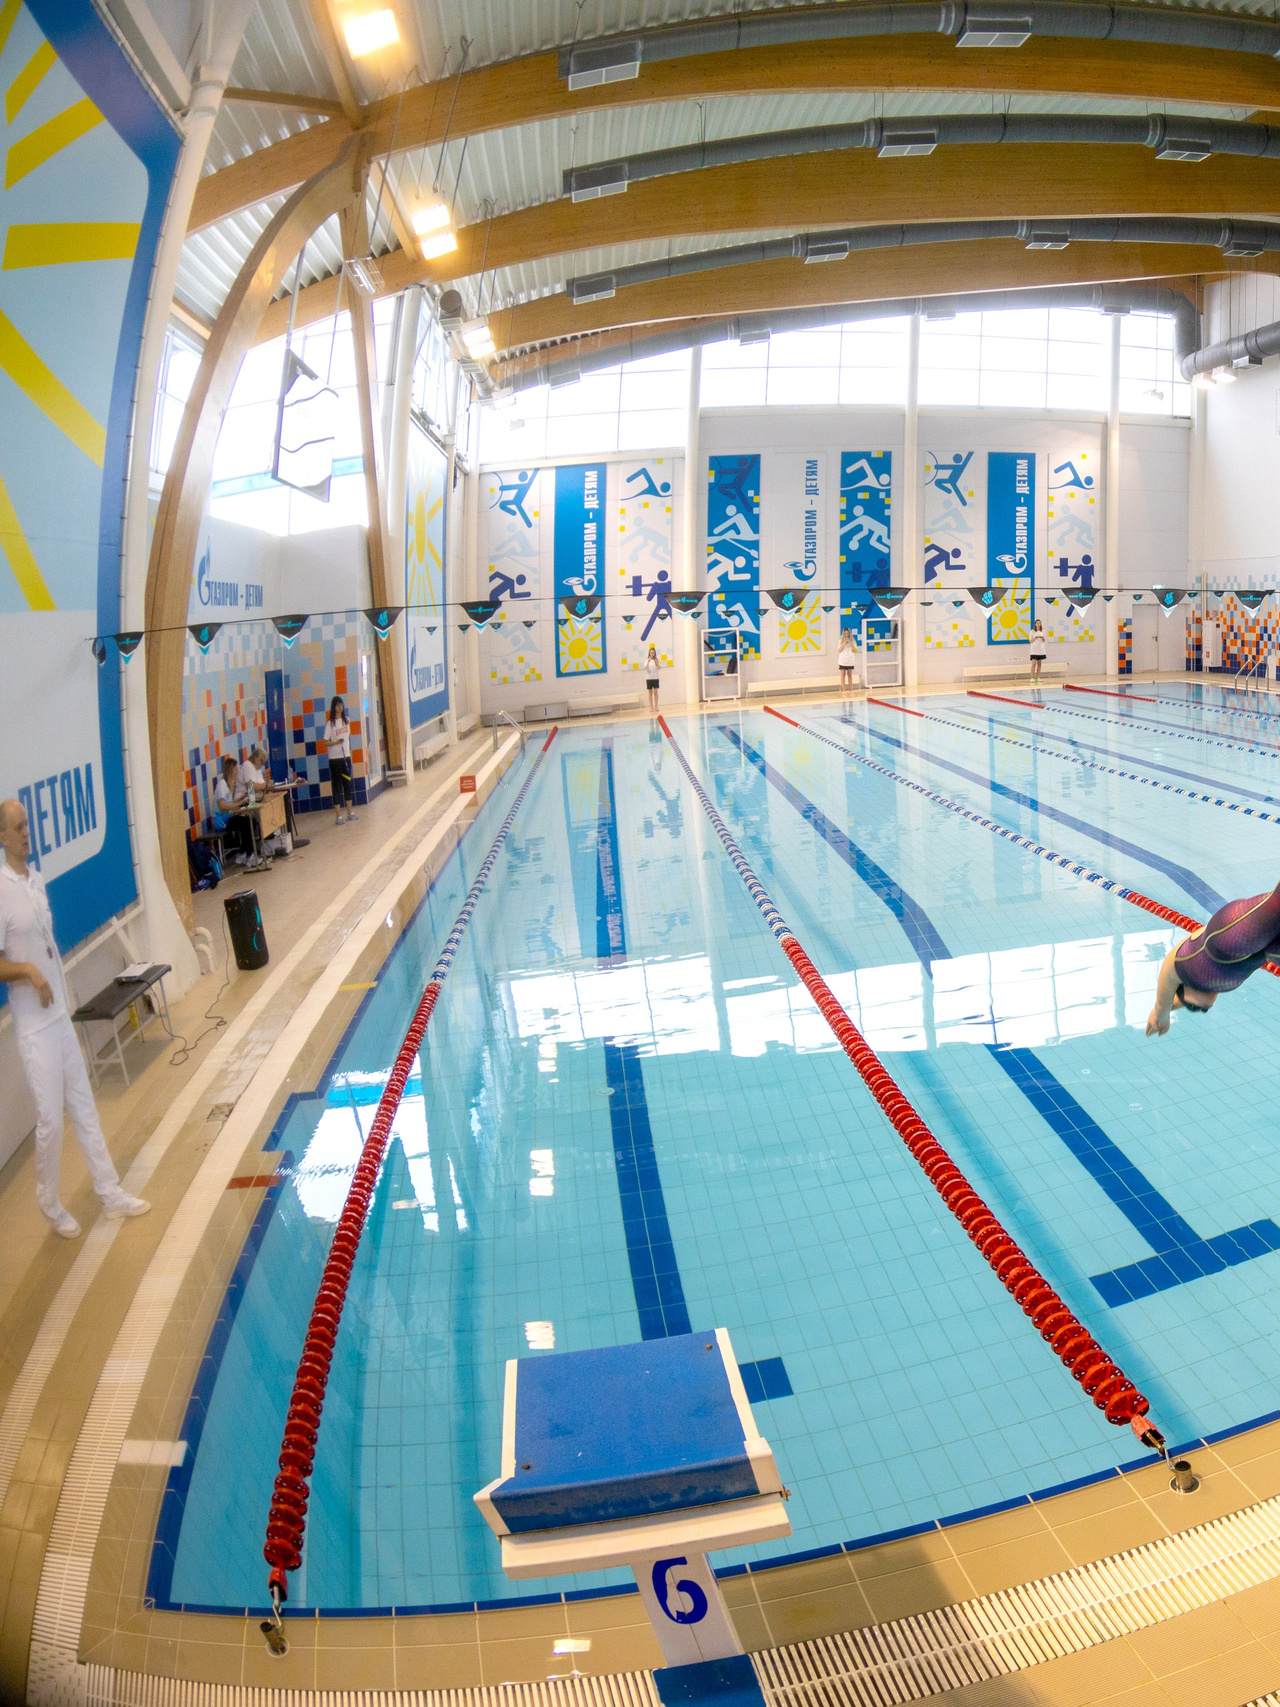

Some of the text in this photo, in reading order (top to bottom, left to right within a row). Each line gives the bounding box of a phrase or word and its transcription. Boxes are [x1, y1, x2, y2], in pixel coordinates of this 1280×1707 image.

[583, 470, 599, 509] ДЕТЯМ
[805, 459, 819, 495] ДЕТЯМ
[1016, 459, 1029, 494] ДЕТЯМ
[584, 523, 597, 575] ГАЗПРОМ
[805, 509, 817, 559] ГАЗПРОМ
[1016, 506, 1028, 553] ГАЗПРОМ
[18, 762, 97, 873] ДЕТЯМ
[651, 1556, 709, 1625] 6
